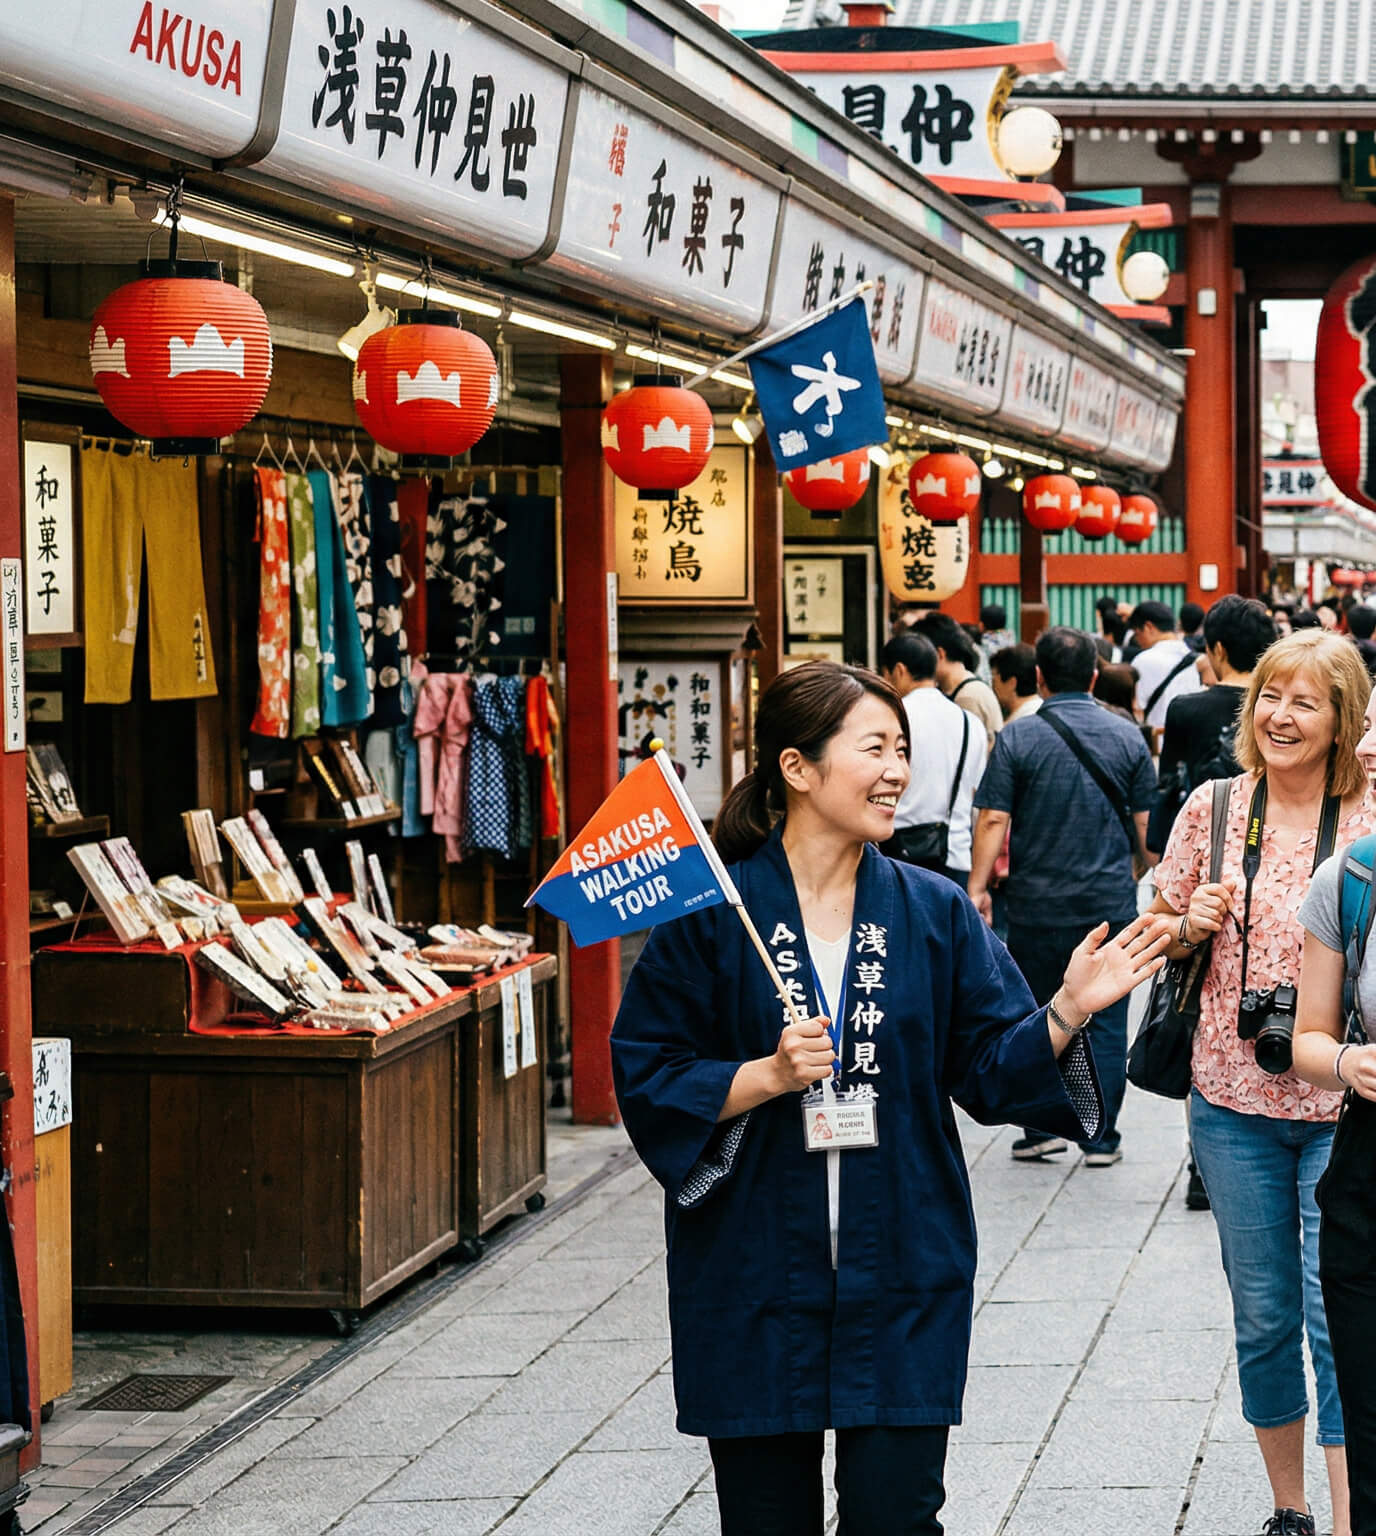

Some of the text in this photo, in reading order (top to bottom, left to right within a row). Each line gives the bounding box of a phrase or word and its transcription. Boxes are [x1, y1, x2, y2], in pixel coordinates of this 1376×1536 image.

[130, 0, 243, 97] AKUSA
[312, 4, 538, 201] 浅草仲見世
[642, 157, 745, 289] 和菓子
[34, 464, 61, 616] 和菓子
[661, 494, 705, 583] 焼鳥
[689, 671, 712, 769] 和和菓子
[570, 807, 672, 878] ASAKUSA
[580, 836, 681, 904] WALKING
[610, 875, 674, 921] TOUR
